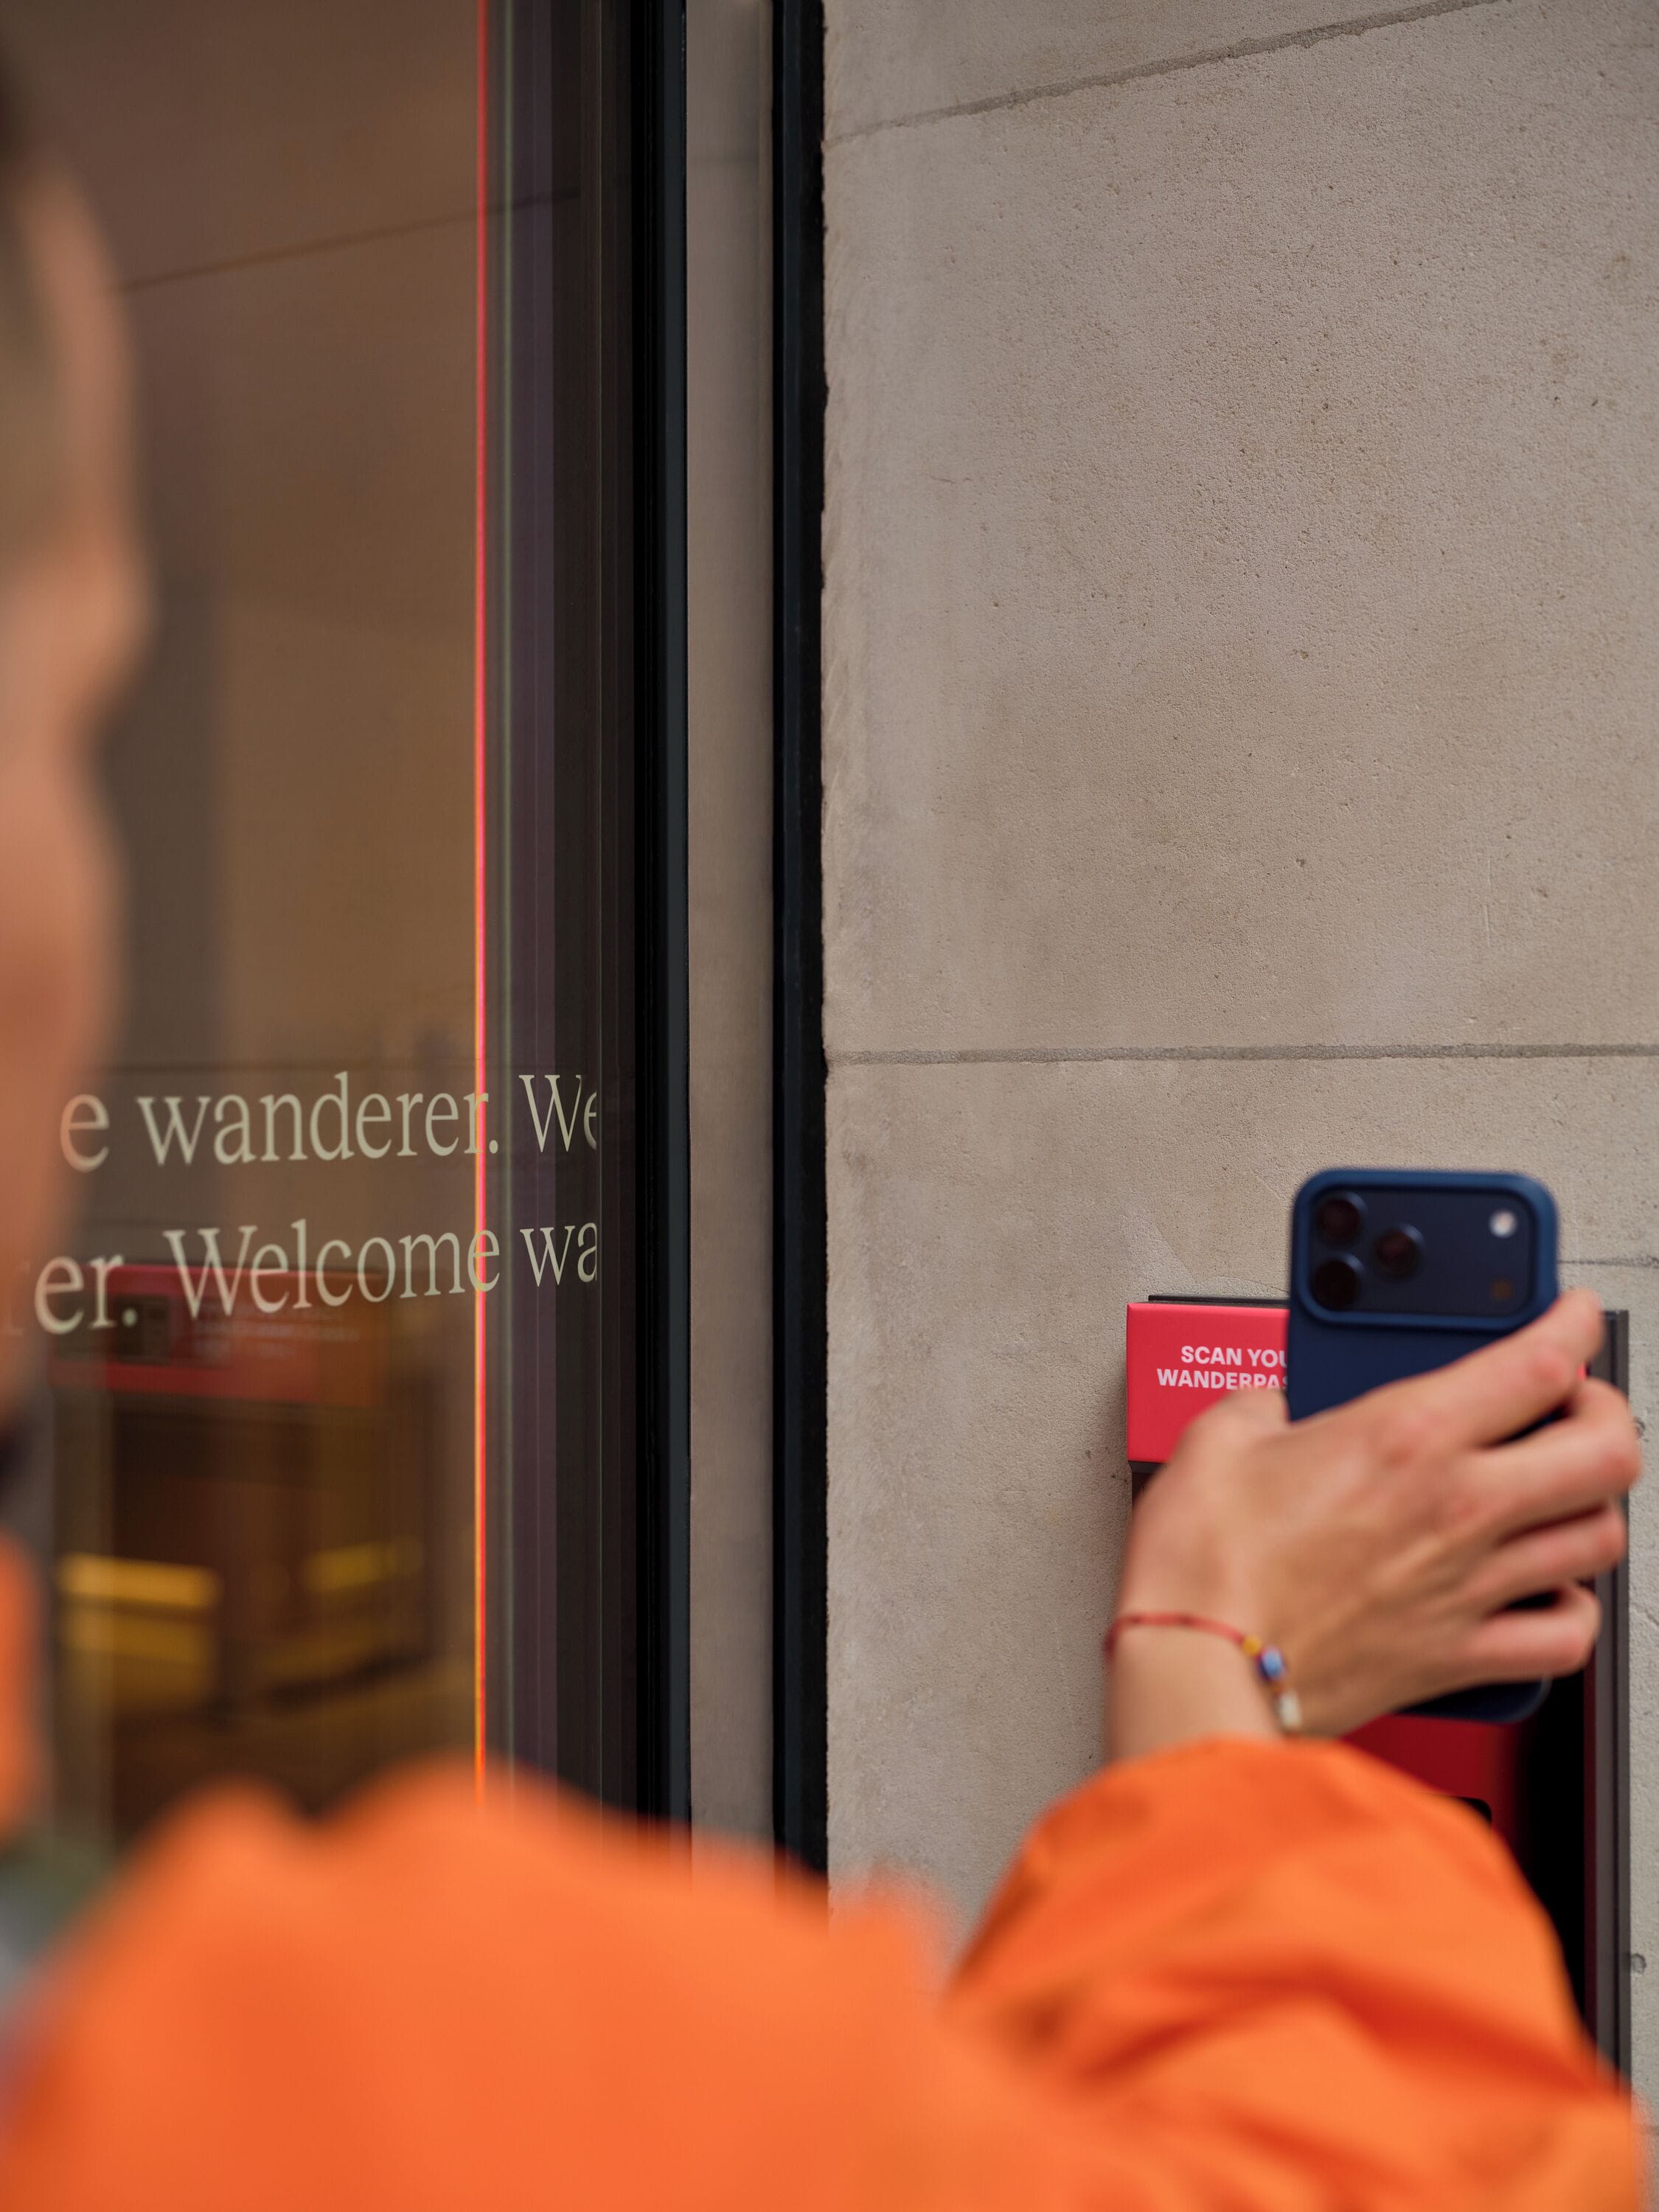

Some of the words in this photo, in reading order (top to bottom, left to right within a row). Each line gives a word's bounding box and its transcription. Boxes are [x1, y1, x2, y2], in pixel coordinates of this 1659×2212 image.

[136, 1071, 499, 1166] wanderer.
[163, 1218, 501, 1319] Welcome
[520, 1222, 597, 1287] wa
[1180, 1346, 1242, 1366] SCAN
